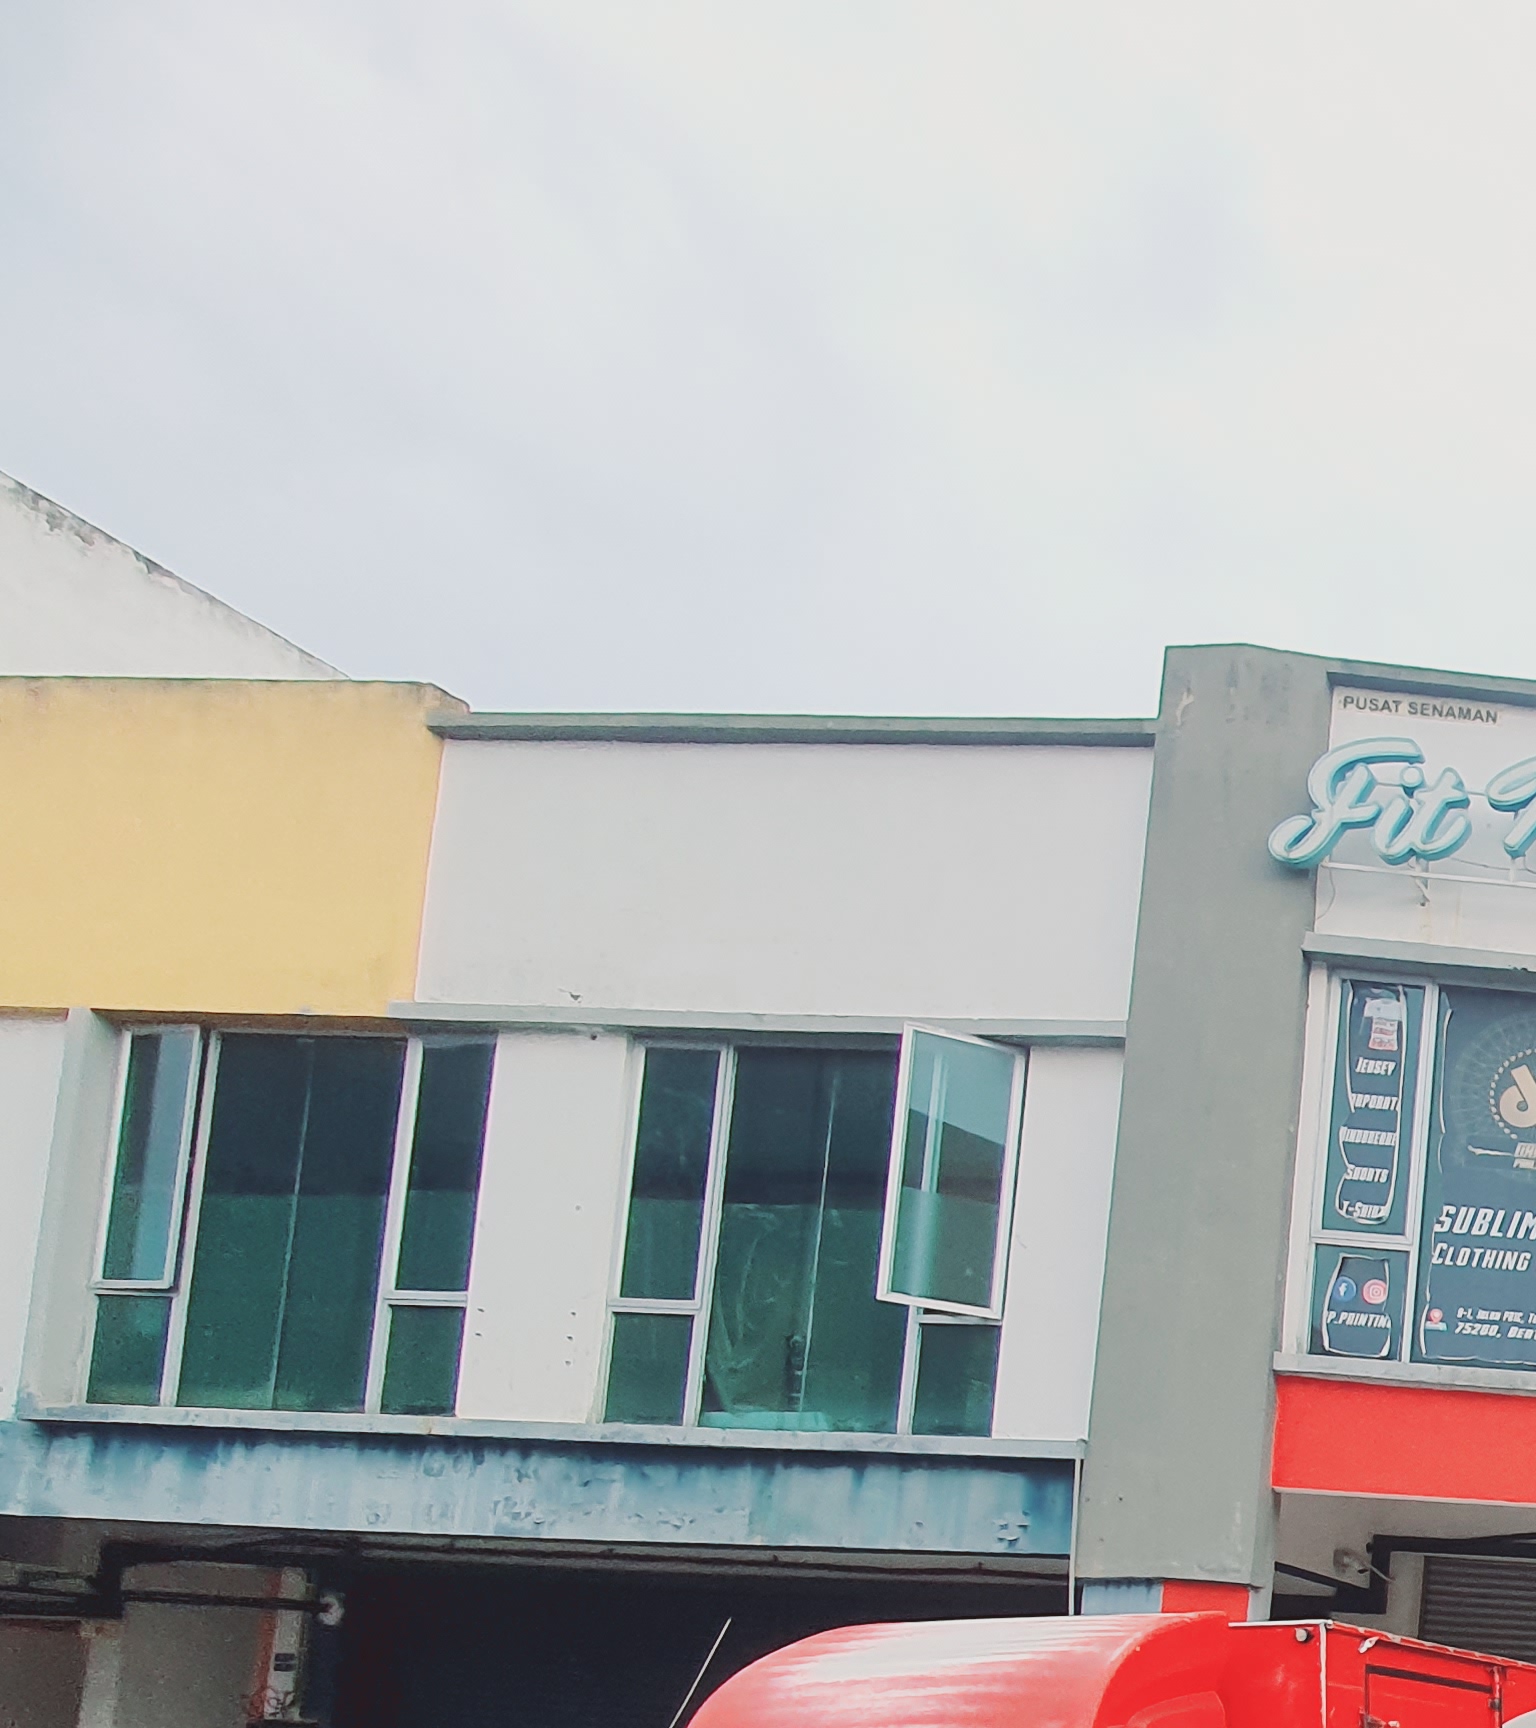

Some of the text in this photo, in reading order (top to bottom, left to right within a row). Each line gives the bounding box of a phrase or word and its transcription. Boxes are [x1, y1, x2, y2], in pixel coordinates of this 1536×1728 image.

[1343, 695, 1498, 724] PUSAT SENAMAN
[1268, 736, 1471, 868] Fit
[1355, 1056, 1396, 1076] JERSEY
[1346, 1163, 1389, 1183] SHORTS
[1432, 1242, 1531, 1272] CLOTHING
